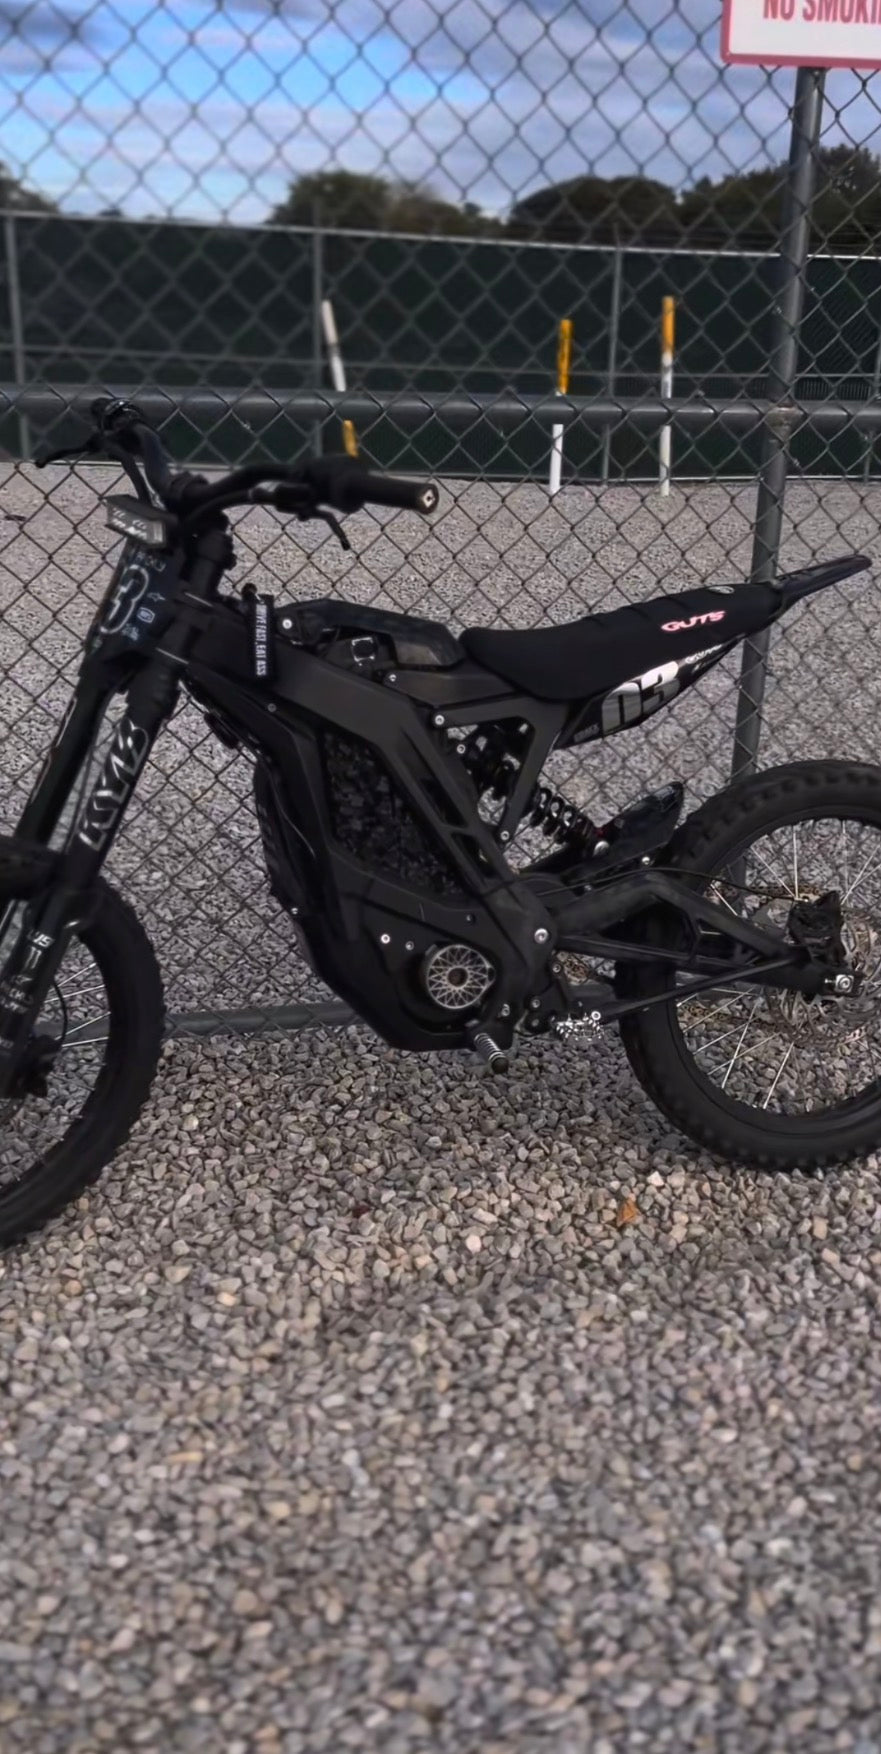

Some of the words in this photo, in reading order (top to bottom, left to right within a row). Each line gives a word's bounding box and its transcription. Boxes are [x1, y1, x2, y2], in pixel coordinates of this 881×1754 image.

[763, 0, 795, 20] NO
[802, 0, 881, 24] SMOKI
[660, 610, 726, 631] GUTS
[255, 645, 267, 658] EAT
[255, 660, 267, 676] ASS
